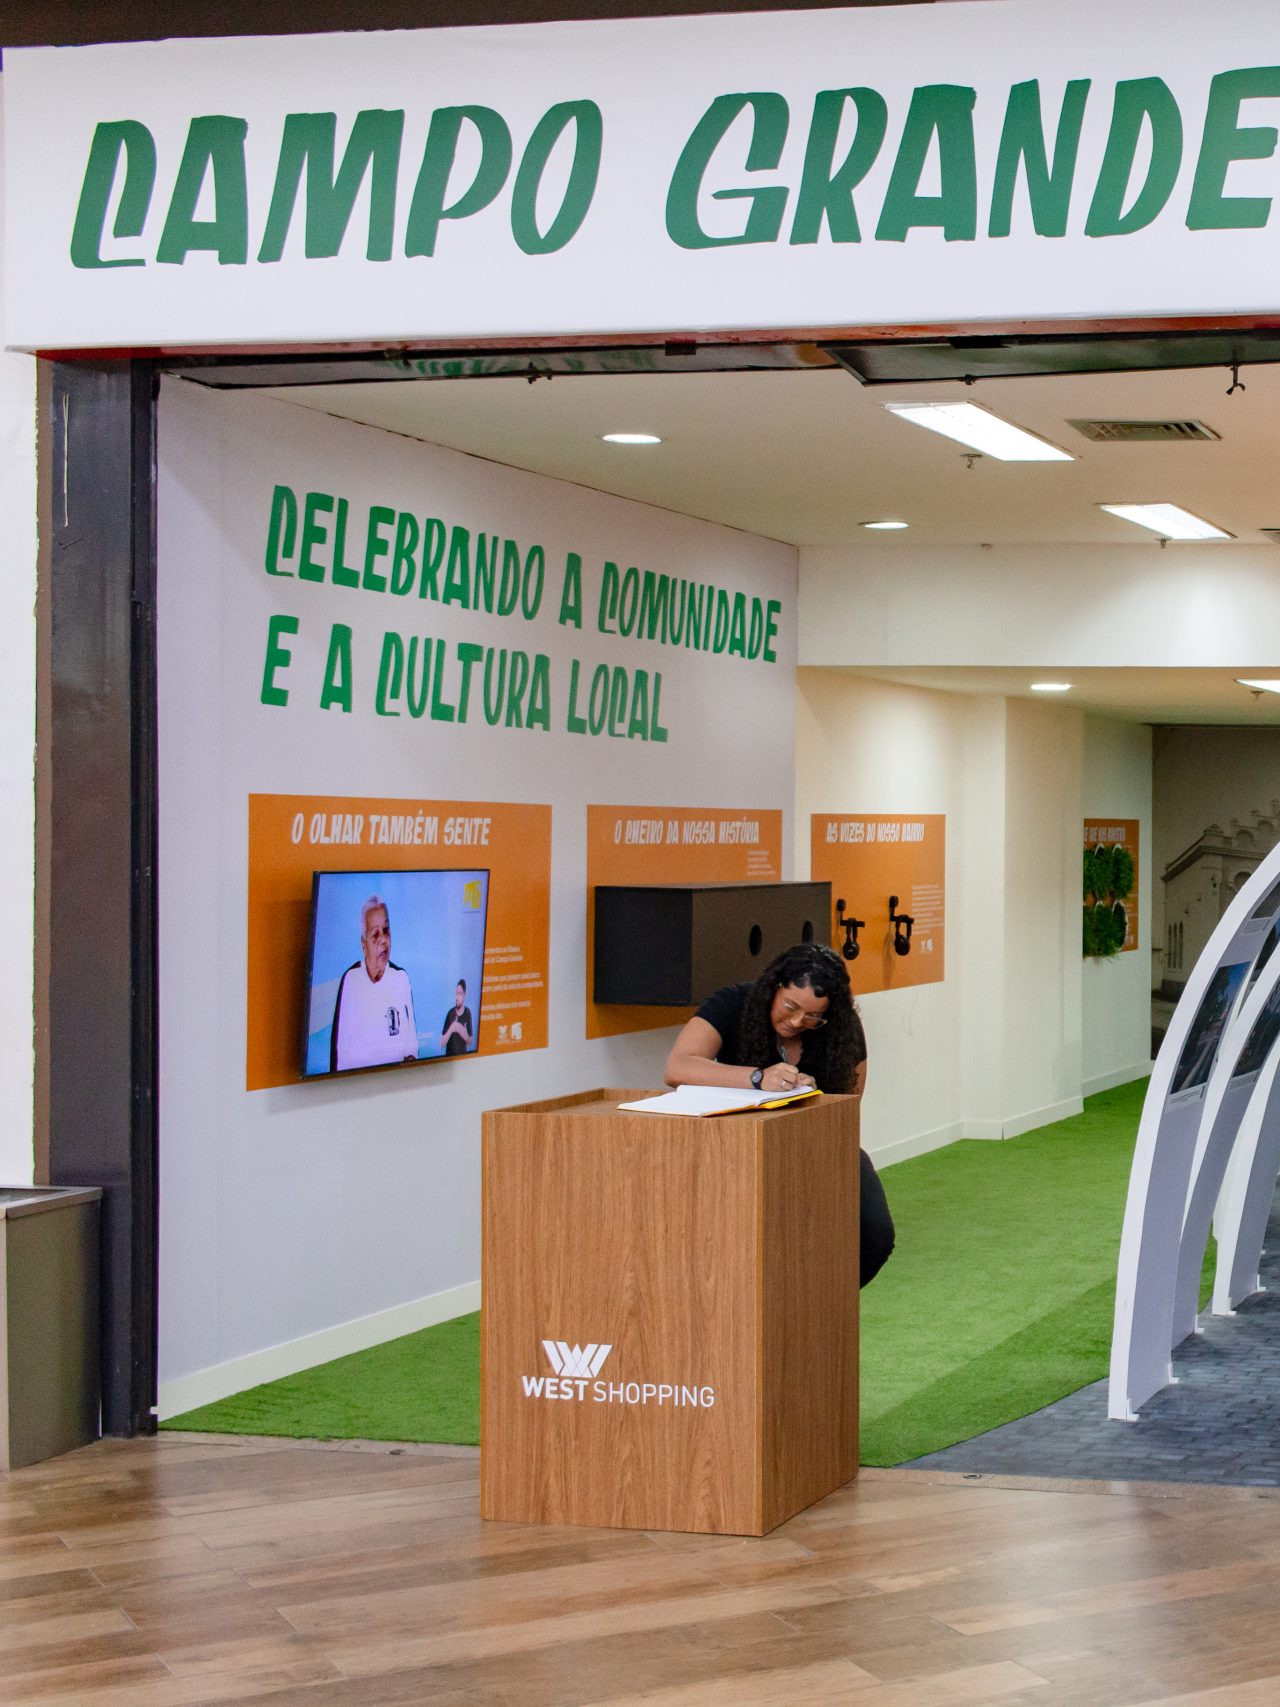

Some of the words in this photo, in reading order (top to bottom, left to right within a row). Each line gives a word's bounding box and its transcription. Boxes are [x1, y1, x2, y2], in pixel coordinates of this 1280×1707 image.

[70, 99, 603, 269] CAMPO
[265, 485, 545, 620] CELEBRANDO
[559, 552, 583, 630] A
[598, 561, 783, 663] COMUNIDADE
[261, 614, 299, 708] E
[320, 623, 353, 714] A
[375, 631, 551, 732] CULTURA
[567, 658, 669, 744] LOCAL
[291, 813, 304, 844] O
[309, 813, 364, 844] OLHAR
[369, 809, 439, 845] TAMBÉM
[444, 817, 491, 845] SENTE
[614, 819, 622, 844] O
[666, 821, 679, 845] DA
[682, 821, 715, 844] NOSSA
[719, 816, 760, 844] HISTÓRIA
[827, 822, 838, 843] AS
[840, 822, 865, 842] VOZES
[866, 823, 876, 842] DO
[878, 822, 900, 842] NOSSO
[522, 1375, 589, 1401] WEST
[593, 1380, 715, 1408] SHOPPING
